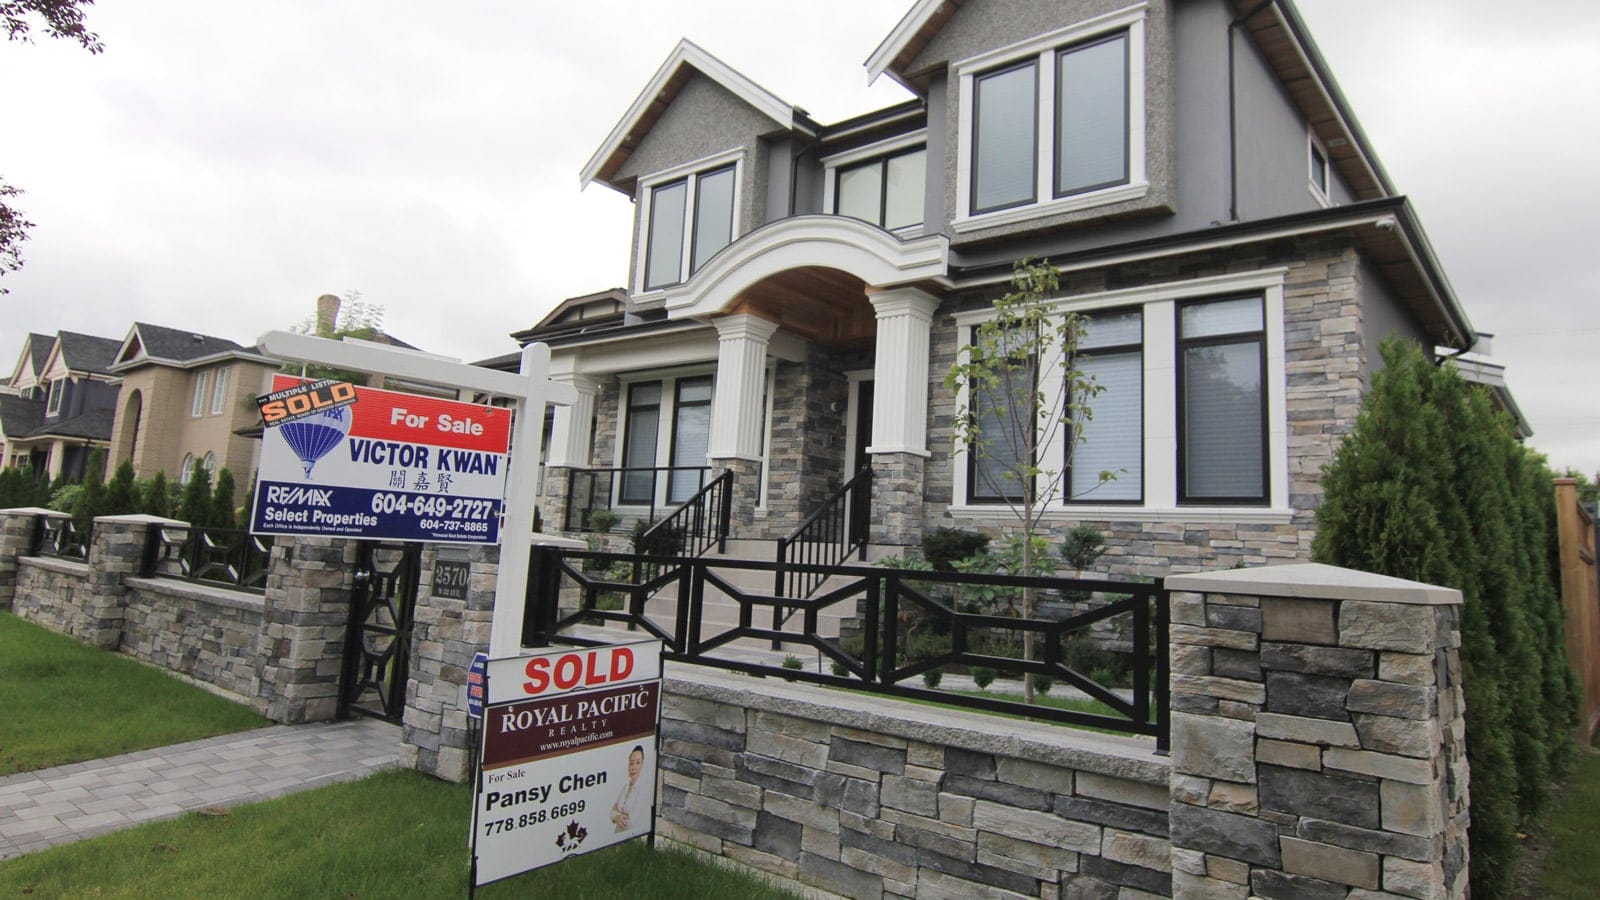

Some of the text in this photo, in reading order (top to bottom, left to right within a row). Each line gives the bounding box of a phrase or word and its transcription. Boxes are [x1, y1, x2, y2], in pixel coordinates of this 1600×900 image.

[261, 382, 356, 422] SOLD
[269, 386, 308, 401] MULTIPLE
[390, 407, 484, 436] For Sale
[349, 438, 430, 469] VICTOR
[266, 486, 333, 507] RE/MAX
[371, 492, 493, 520] 604-649-2727
[265, 507, 378, 526] Select Properties
[420, 519, 488, 532] 604-737-8865
[523, 647, 634, 695] SOLD
[500, 691, 649, 733] ROYAL PACIFIC
[540, 730, 614, 751] www.royalpacific.com
[548, 719, 609, 737] REALTY
[488, 769, 526, 784] For Sale
[486, 771, 608, 811] Pansy Chen
[484, 800, 586, 836] 778.858.6699
